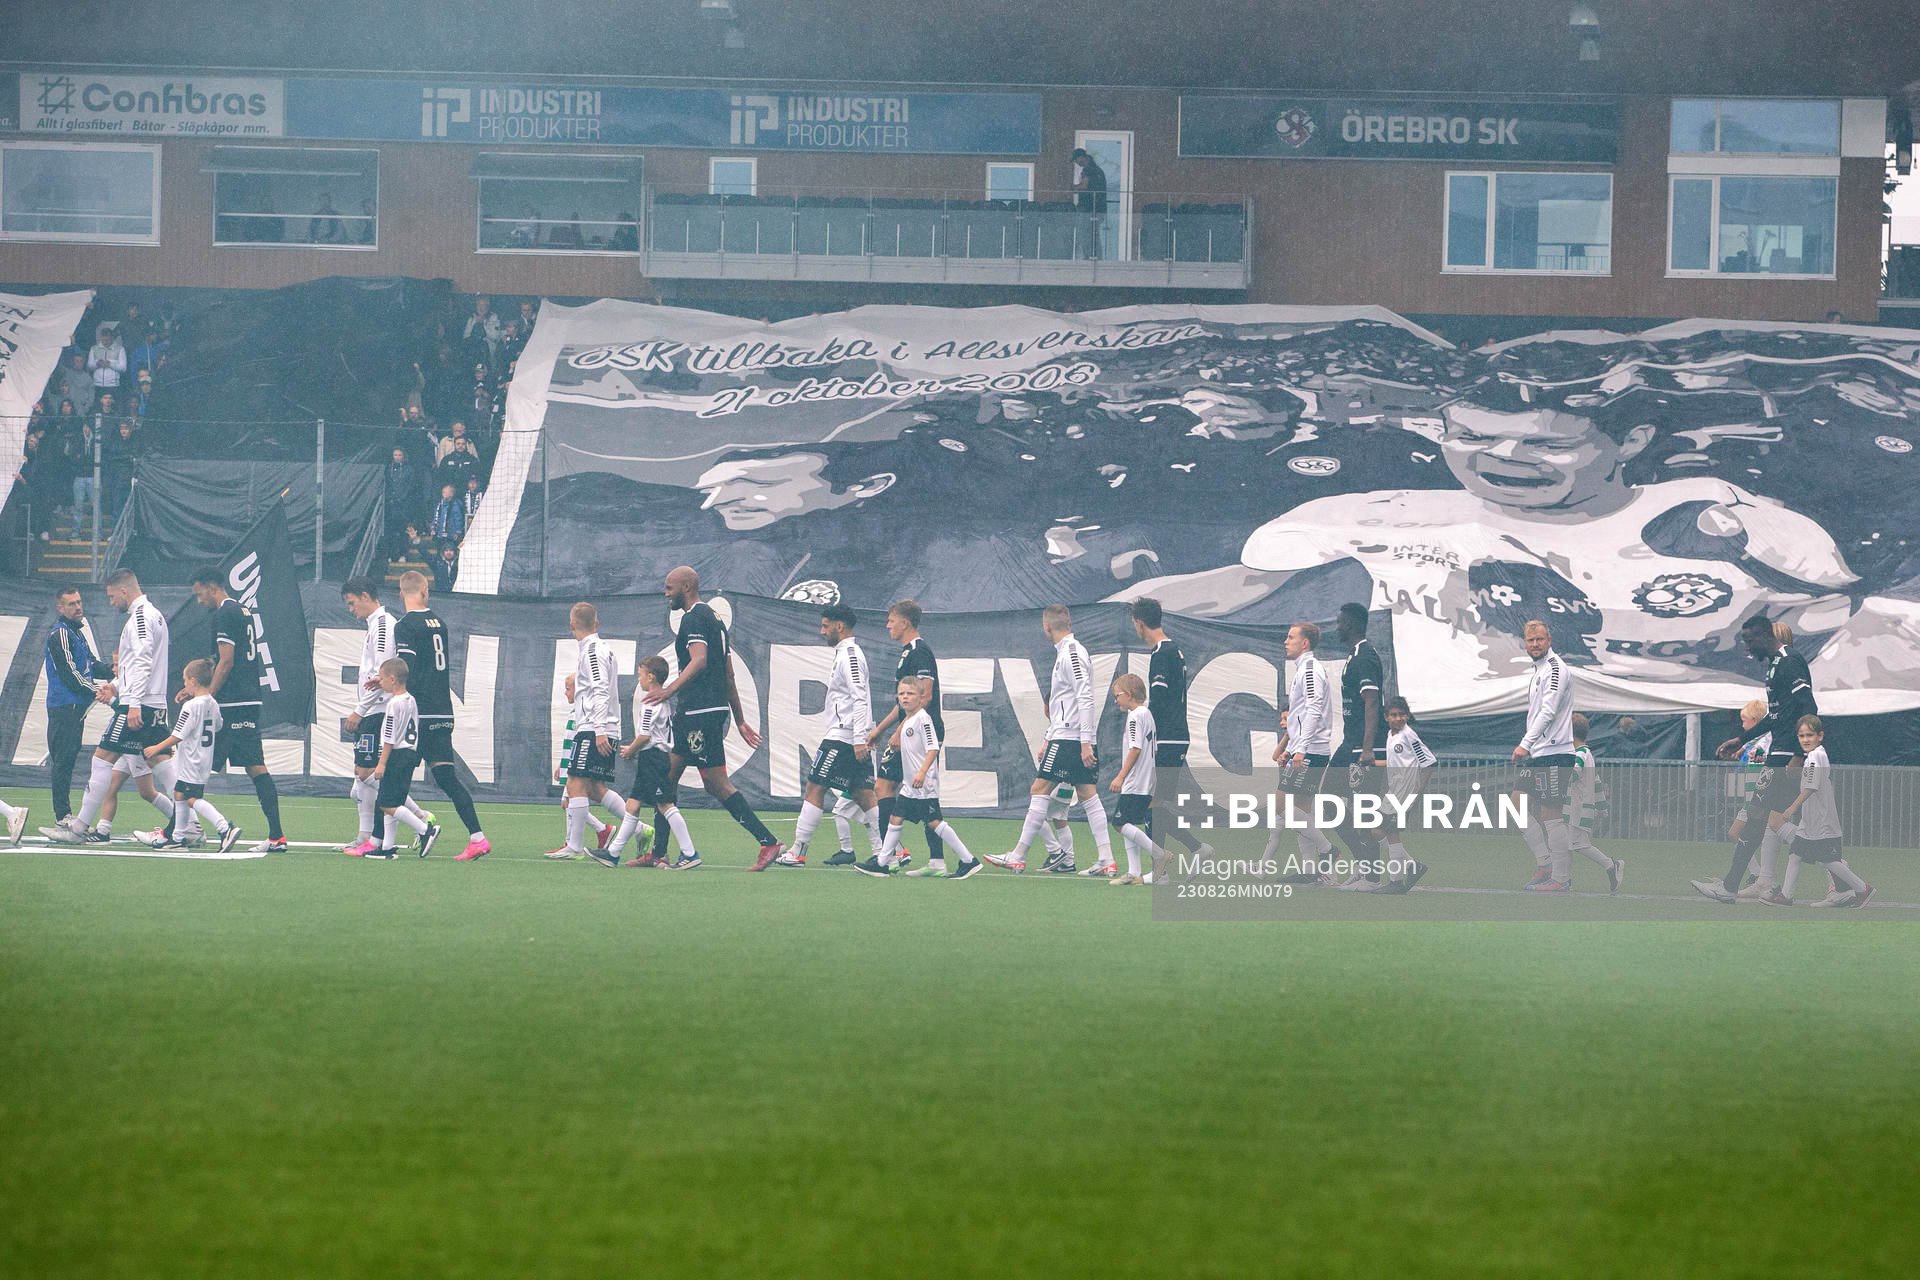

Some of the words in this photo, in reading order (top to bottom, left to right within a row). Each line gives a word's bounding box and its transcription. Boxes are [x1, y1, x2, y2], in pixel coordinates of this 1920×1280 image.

[82, 83, 267, 116] Confibras
[479, 89, 601, 115] INDUSTRI
[787, 97, 909, 122] INDUSTRI
[37, 118, 57, 129] Allt
[66, 118, 123, 132] glasfiber!
[132, 119, 165, 132] Båtar
[243, 125, 271, 134] mm.
[479, 117, 601, 140] PRODUKTER
[787, 124, 909, 147] PRODUKTER
[1341, 109, 1471, 143] ÖREBRO
[1478, 118, 1519, 145] SK
[692, 337, 878, 370] tillbaka
[890, 341, 908, 360] i
[924, 324, 1206, 360] Allsvenskan
[702, 385, 758, 417] 21
[768, 375, 942, 406] oktober
[954, 363, 1096, 390] 2006
[1392, 552, 1460, 570] SPORT
[1393, 544, 1460, 562] INTER
[246, 624, 256, 661] 3
[432, 633, 446, 671] 8
[201, 719, 214, 747] 5
[404, 718, 417, 745] 8
